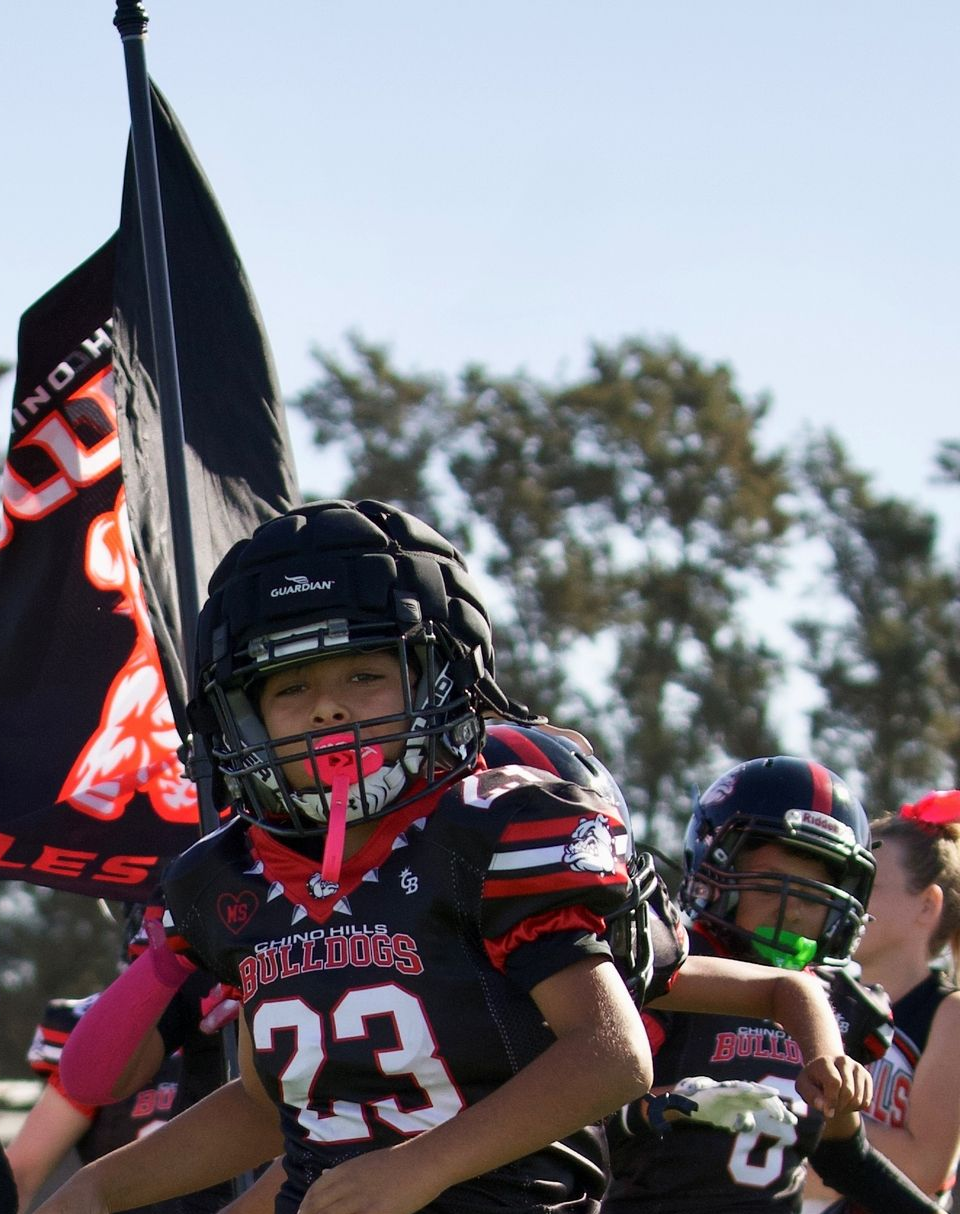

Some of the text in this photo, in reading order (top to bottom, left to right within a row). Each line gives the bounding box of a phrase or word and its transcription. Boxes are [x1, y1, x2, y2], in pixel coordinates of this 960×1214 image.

[10, 361, 75, 432] INO
[271, 581, 332, 597] GUARDIAN
[254, 924, 388, 954] CHINO HILLS
[239, 933, 424, 1004] BULLDOGS
[253, 981, 466, 1145] 23
[711, 1032, 805, 1067] BULLD
